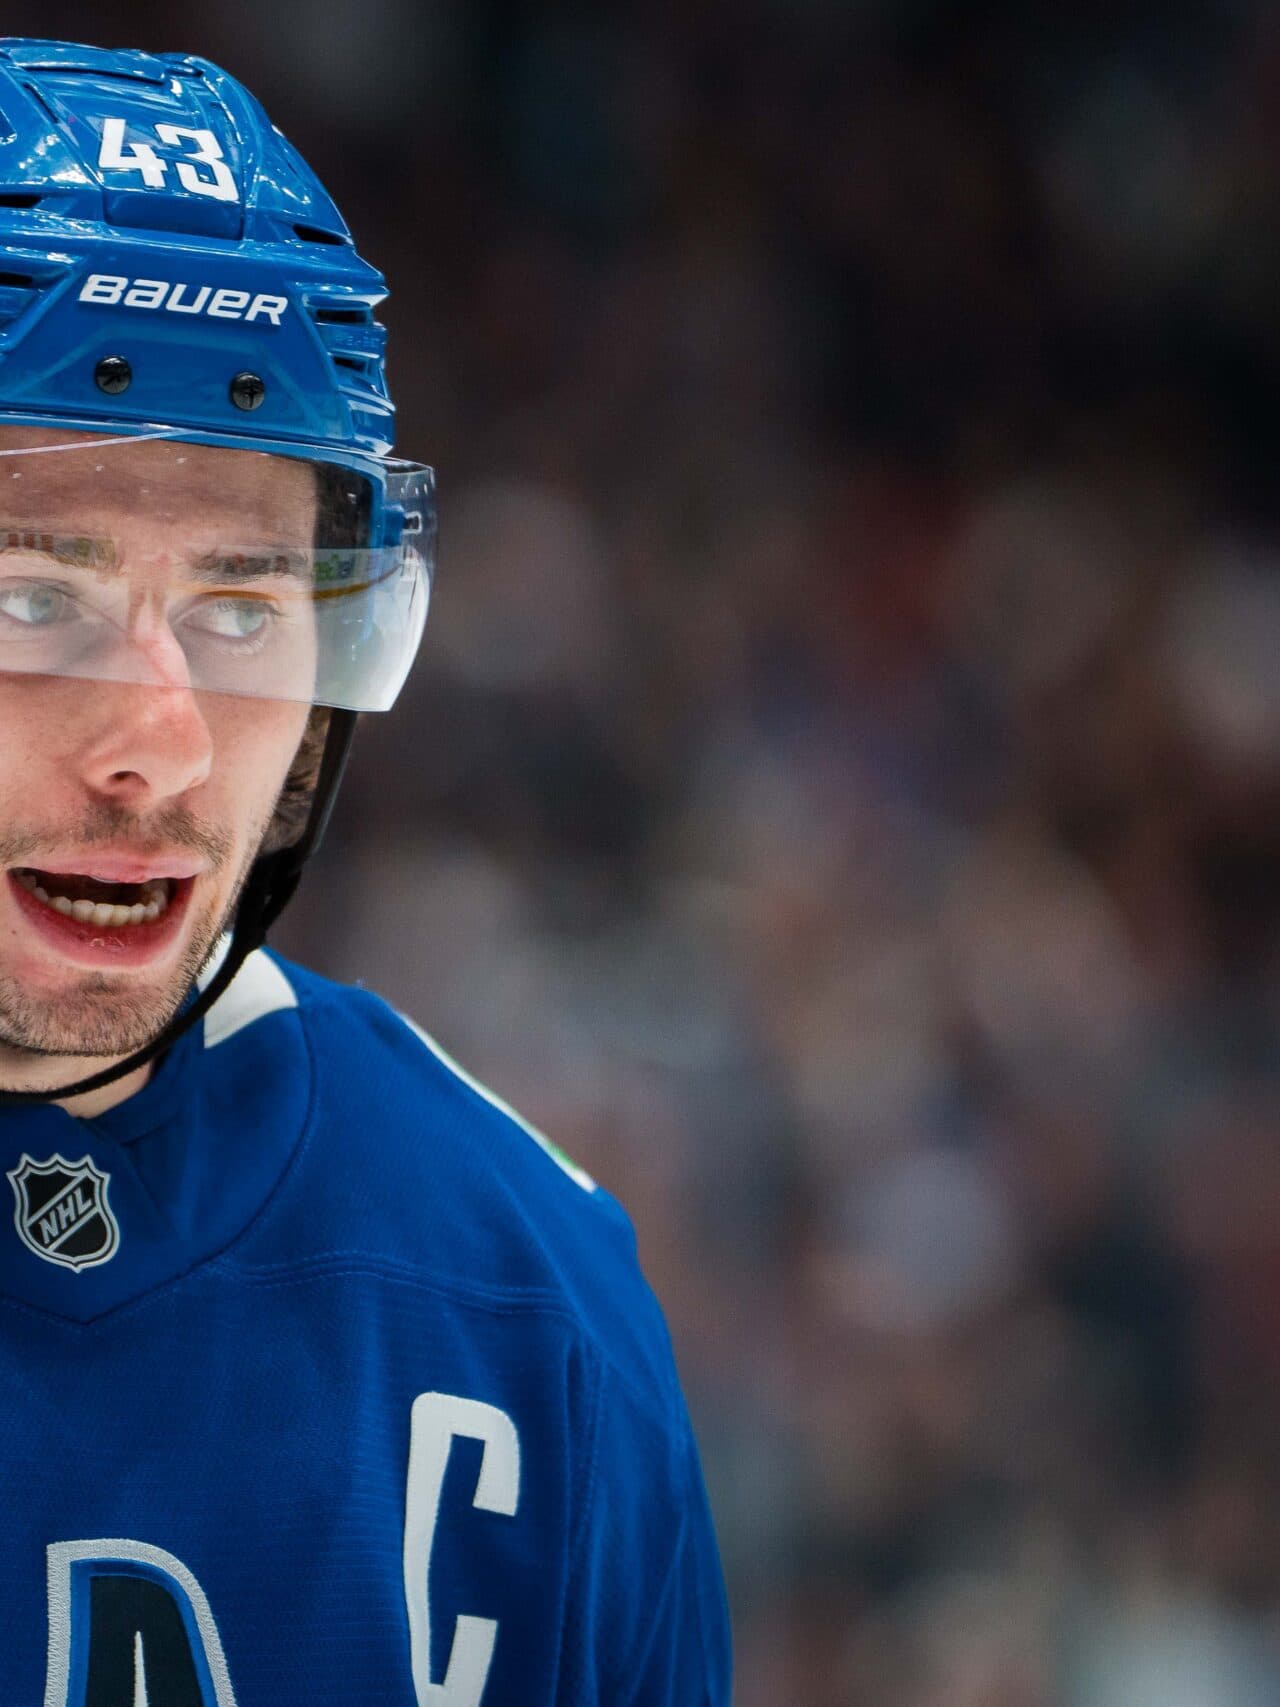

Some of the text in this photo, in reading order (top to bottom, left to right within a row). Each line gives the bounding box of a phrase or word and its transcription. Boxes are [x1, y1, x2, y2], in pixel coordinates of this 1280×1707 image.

[99, 118, 239, 201] 43
[79, 273, 288, 326] BAUER
[38, 1187, 93, 1245] NHL
[403, 1391, 520, 1707] C
